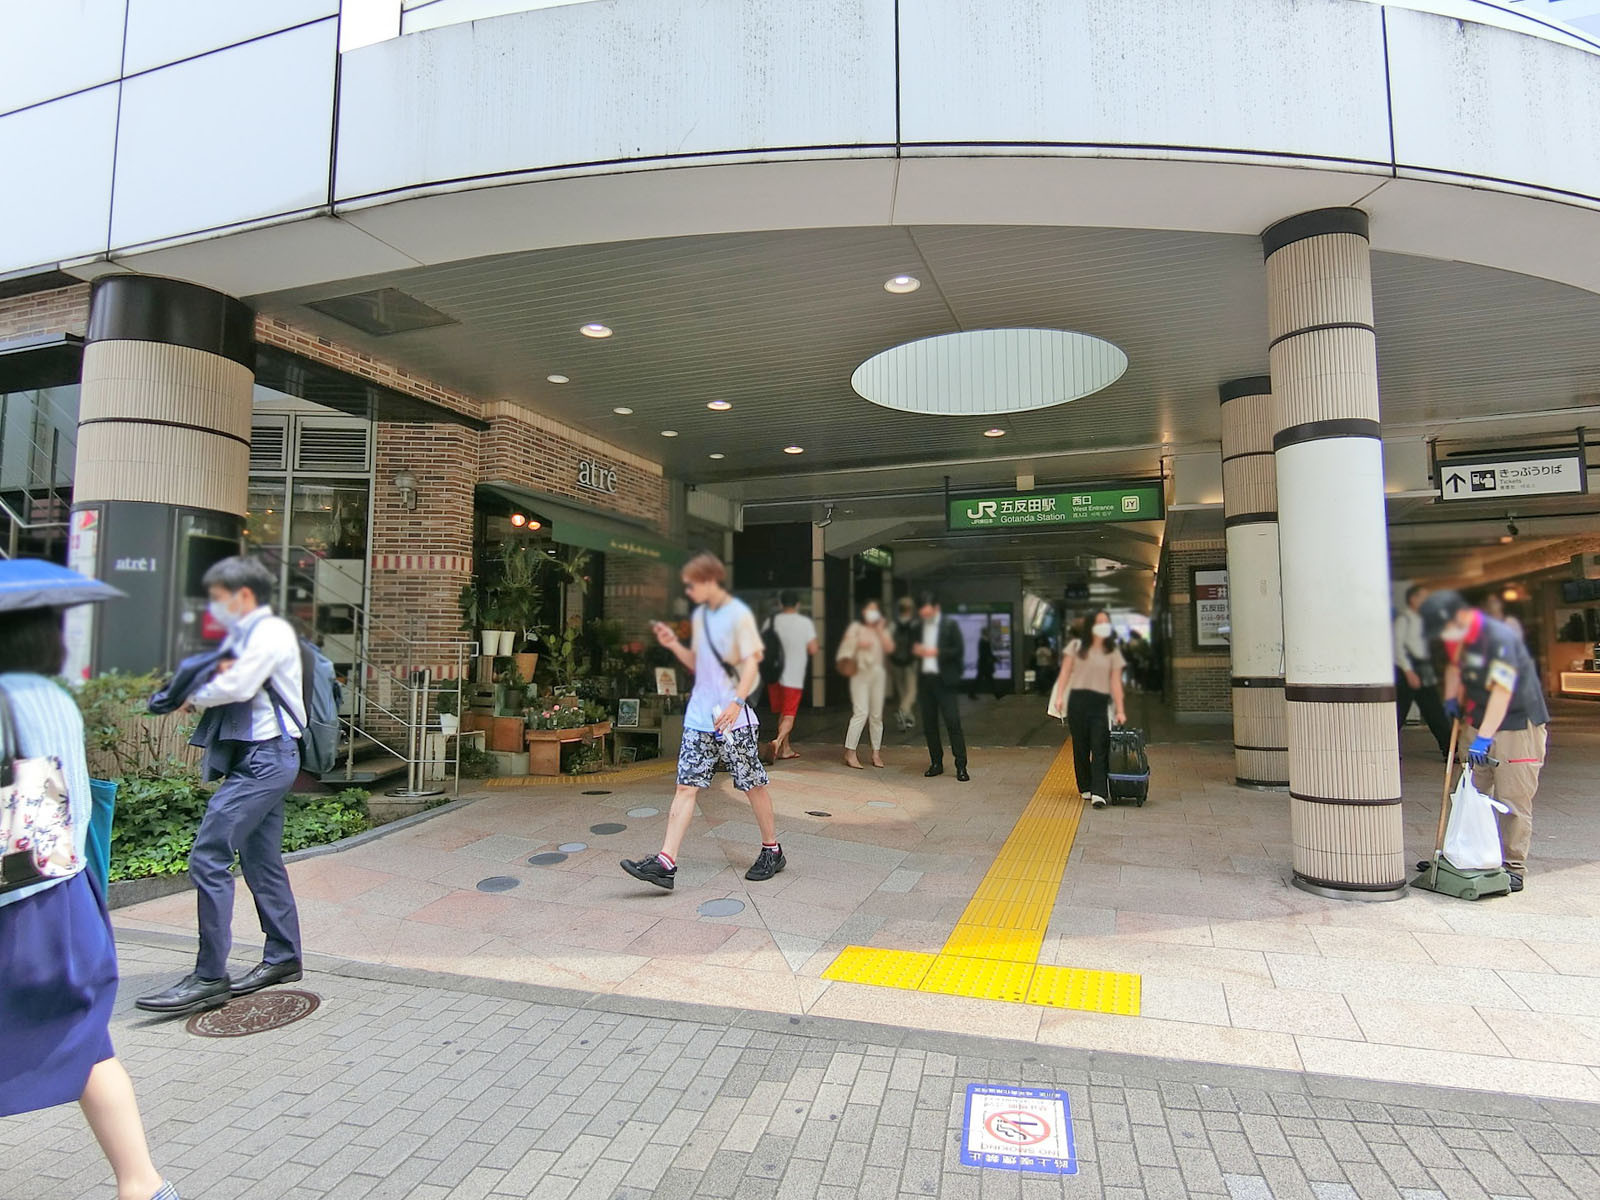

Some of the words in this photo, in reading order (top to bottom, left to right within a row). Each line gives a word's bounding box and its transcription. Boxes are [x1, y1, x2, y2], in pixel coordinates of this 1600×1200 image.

[579, 460, 617, 493] atré
[1500, 464, 1562, 478] きっぷうりば
[1000, 498, 1056, 513] 五反田駅
[1072, 496, 1092, 506] 西口
[967, 501, 997, 519] JR
[1001, 515, 1035, 523] Gotanda
[1036, 513, 1066, 521] Station
[970, 1152, 1069, 1168] 路上喫煙禁止
